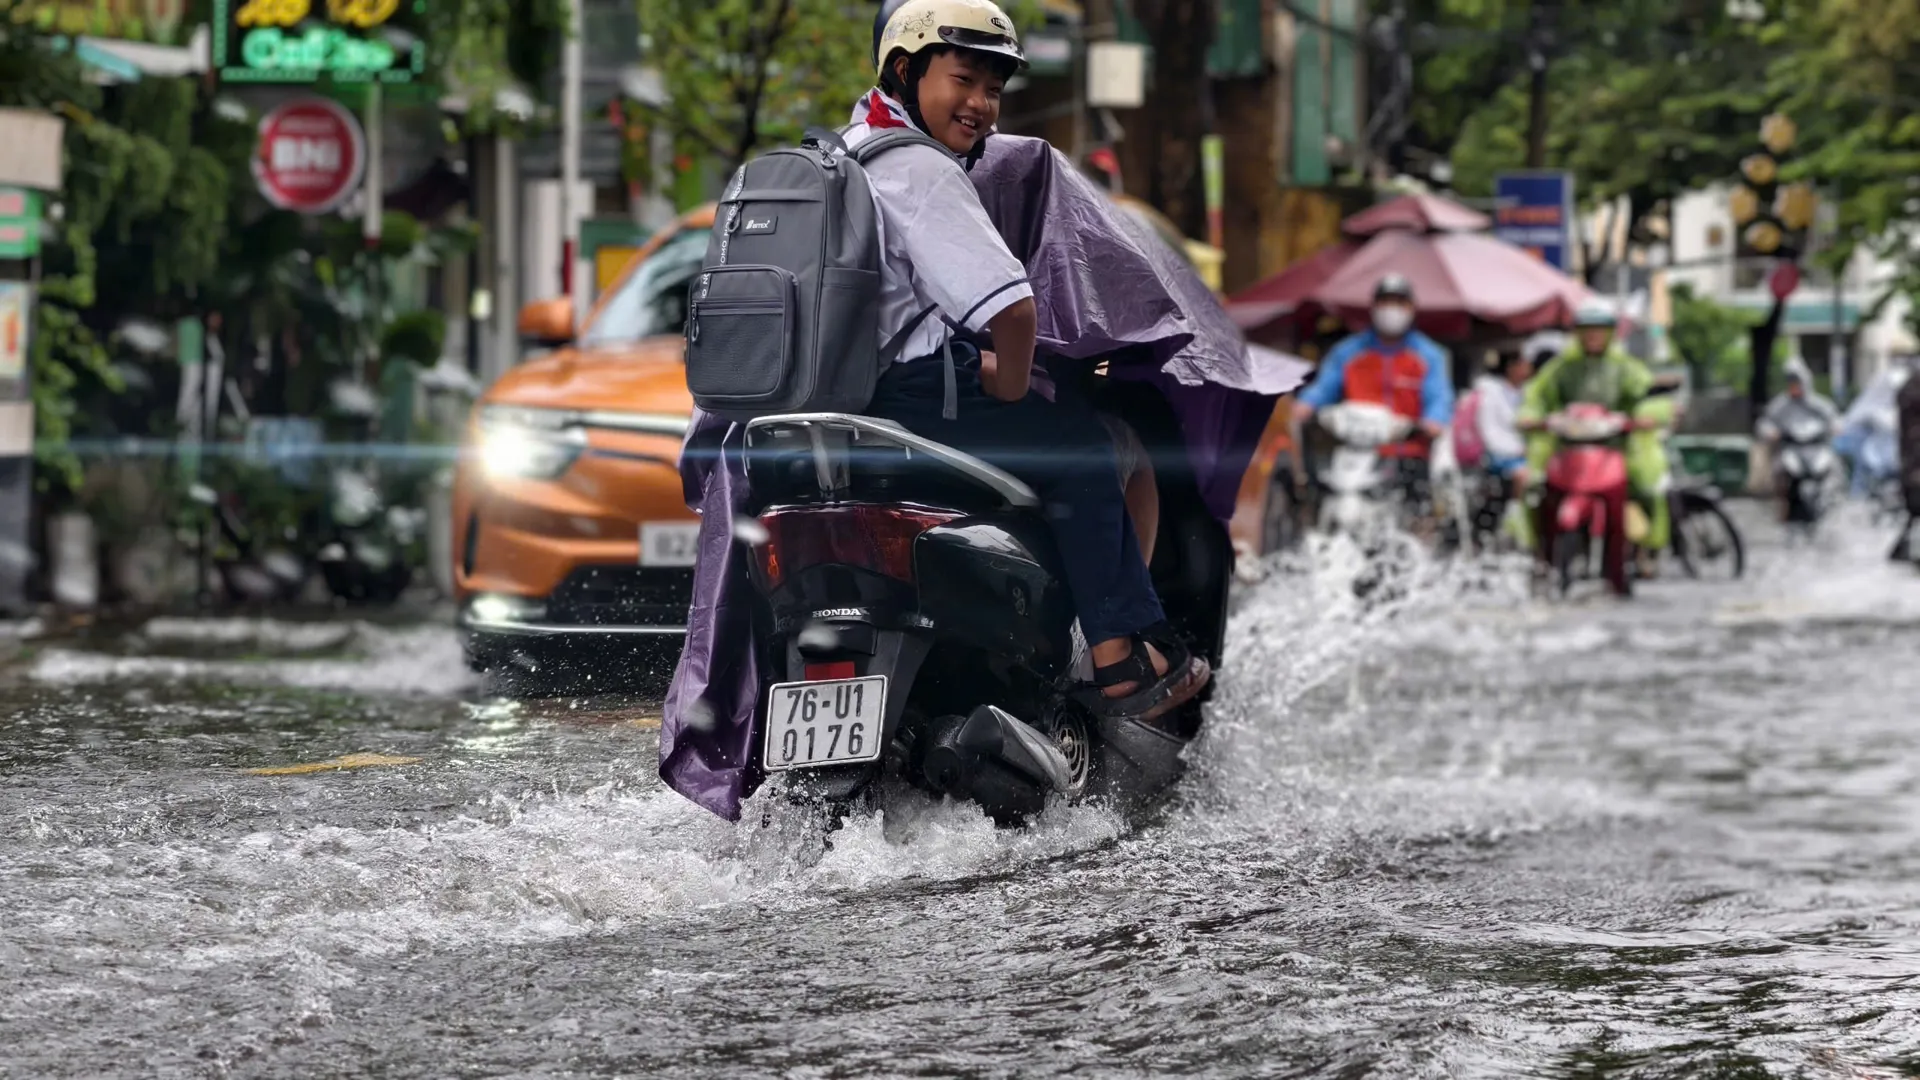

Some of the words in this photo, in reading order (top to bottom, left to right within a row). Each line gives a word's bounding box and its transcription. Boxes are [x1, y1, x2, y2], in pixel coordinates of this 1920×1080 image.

[812, 608, 862, 618] HONDA
[787, 684, 864, 724] 76-U1
[782, 722, 865, 762] 0176
